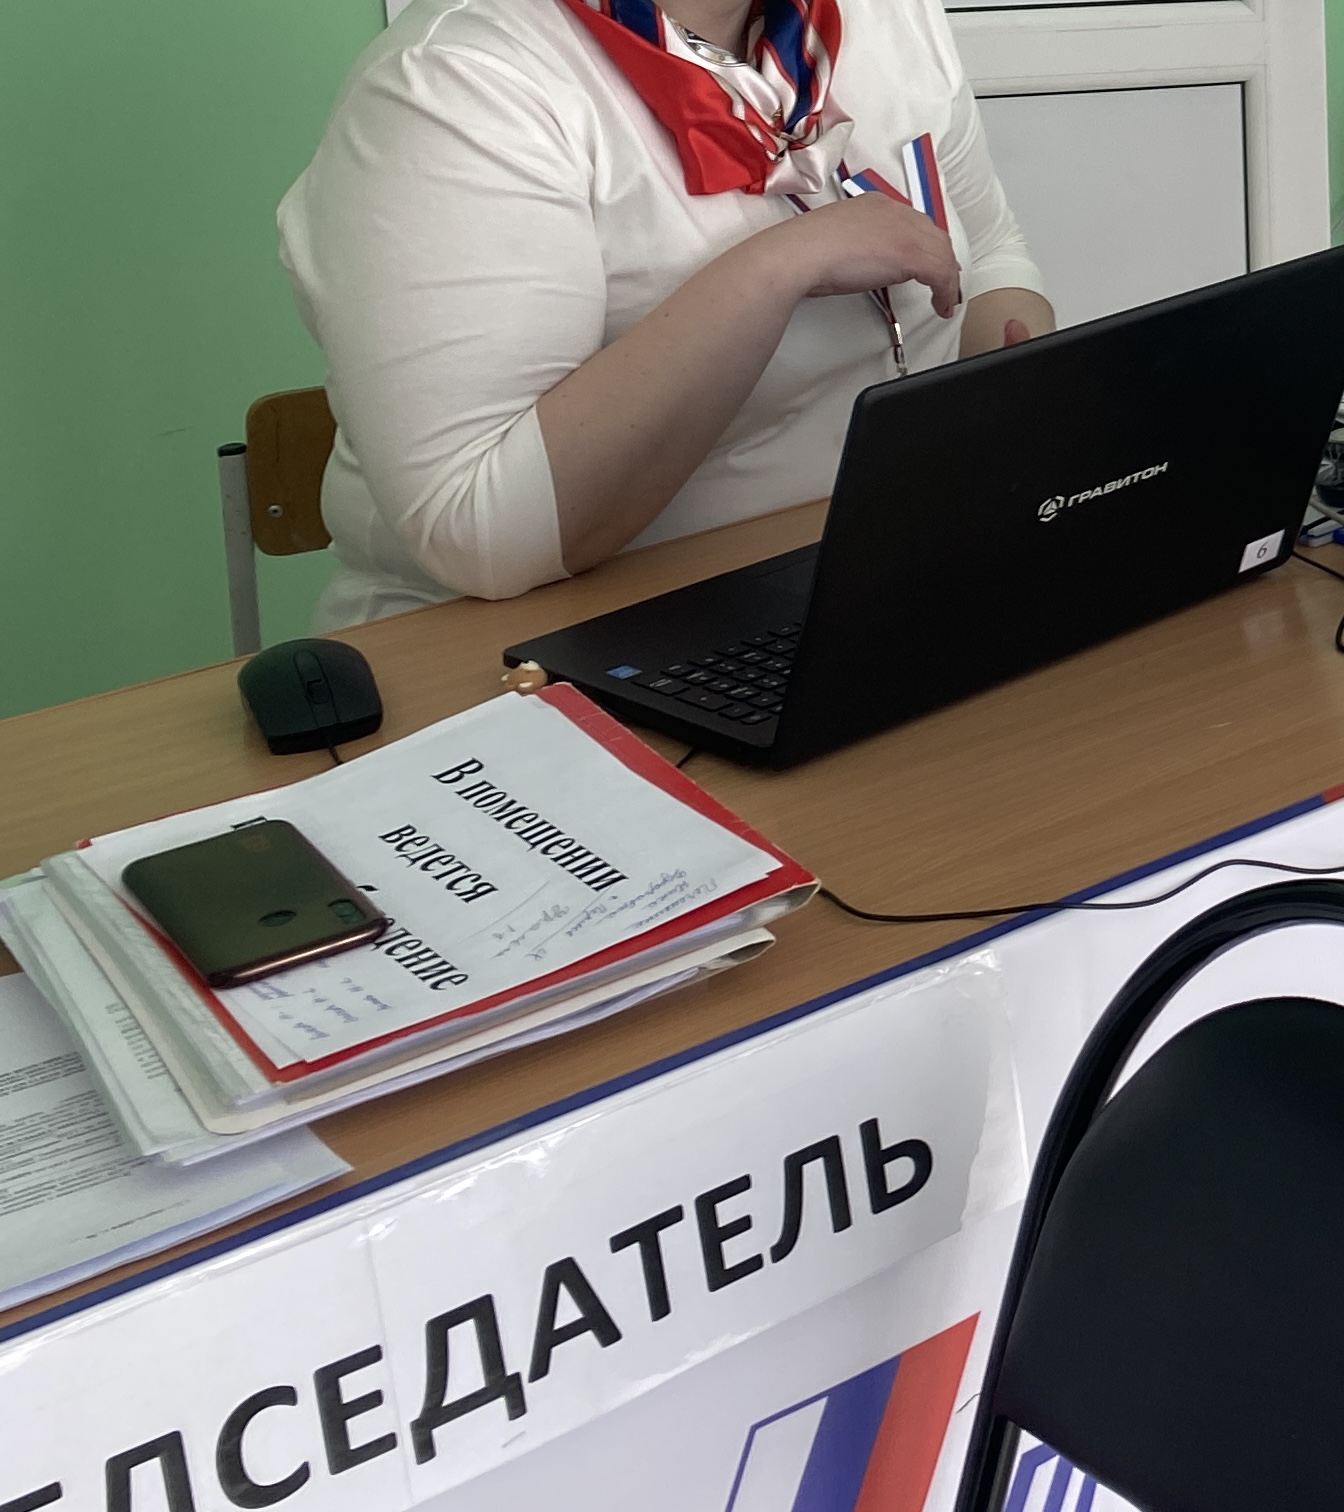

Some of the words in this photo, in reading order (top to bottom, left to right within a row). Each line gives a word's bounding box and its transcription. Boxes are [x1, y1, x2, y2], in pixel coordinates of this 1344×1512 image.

[1068, 462, 1168, 507] ГРАВИТОН
[1256, 542, 1267, 559] 6
[432, 757, 484, 785] В
[454, 779, 629, 892] помещении
[378, 823, 498, 904] ведется
